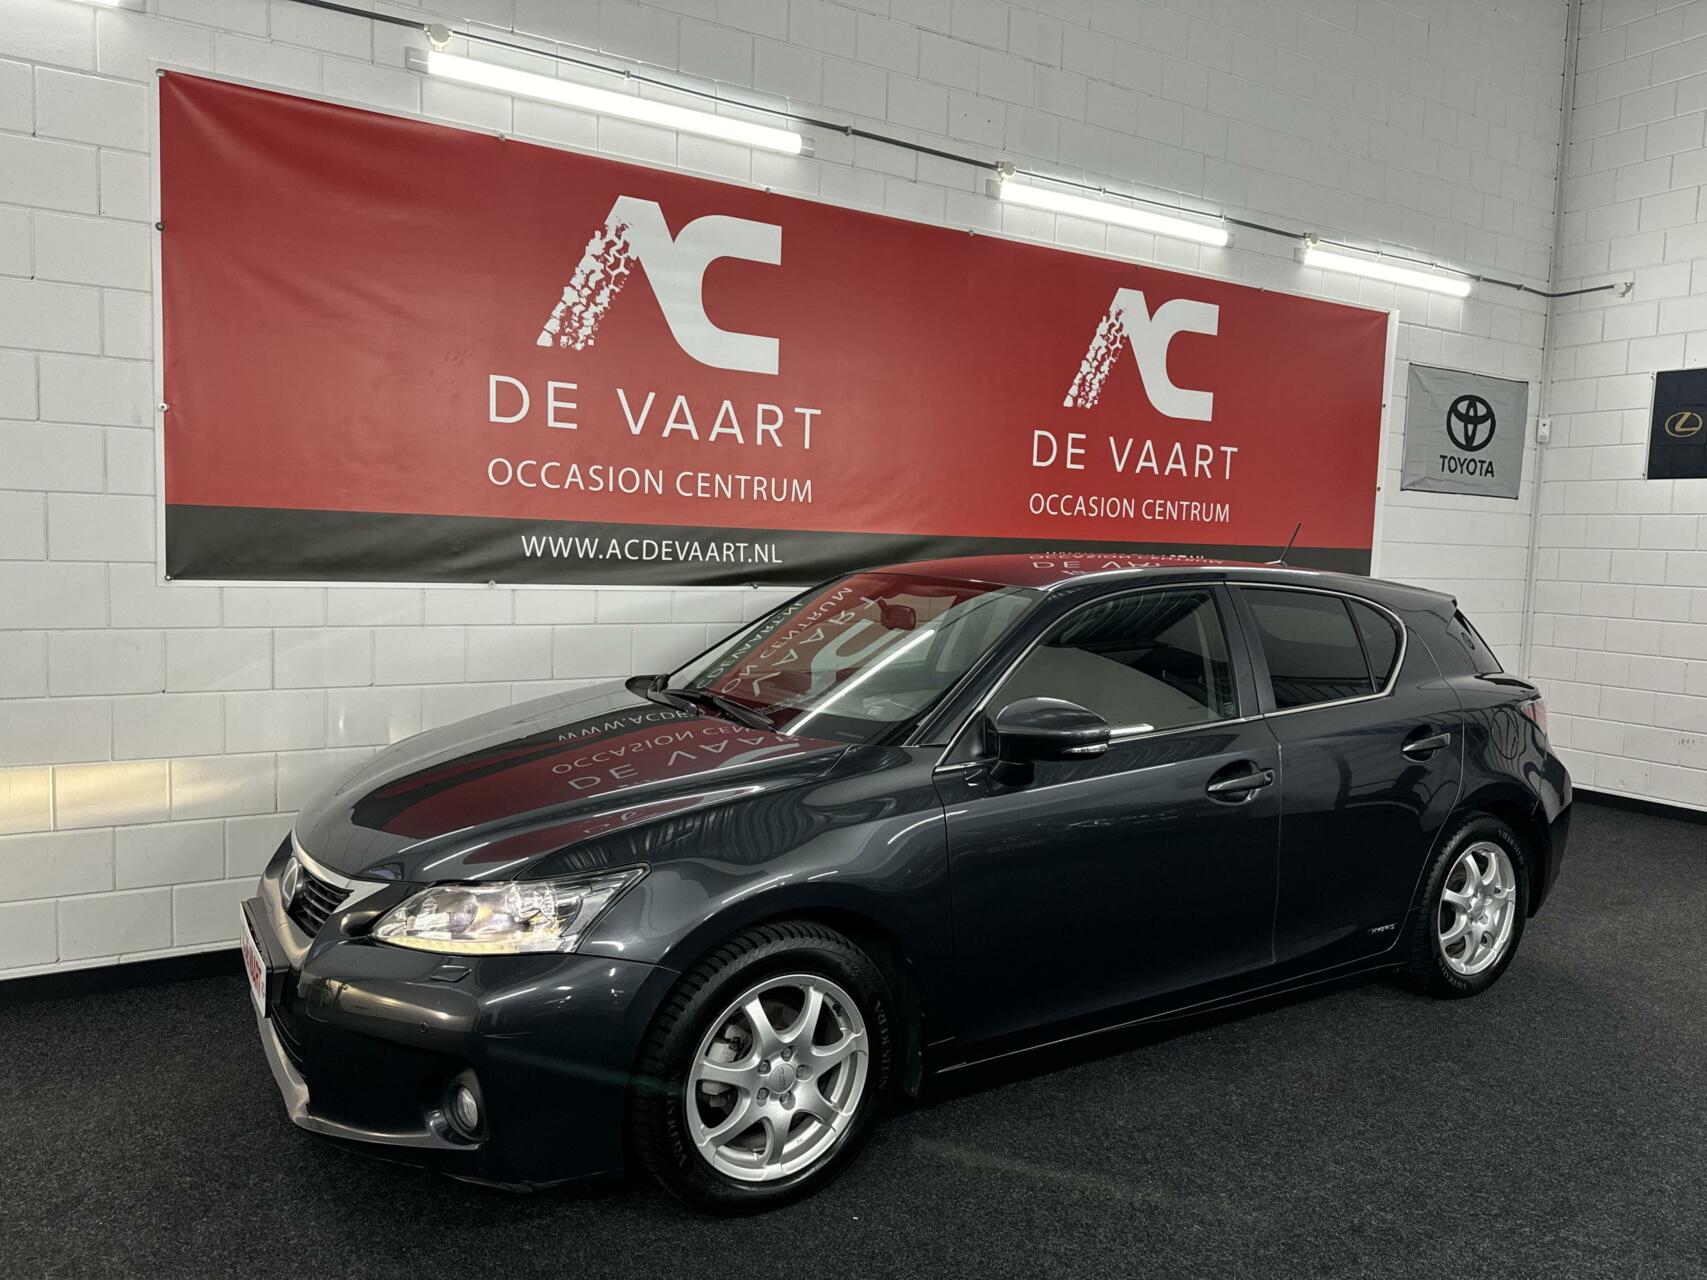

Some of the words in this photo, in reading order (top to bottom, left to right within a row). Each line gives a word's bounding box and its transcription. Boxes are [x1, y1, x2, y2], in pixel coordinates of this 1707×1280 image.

[536, 195, 782, 375] AC
[1063, 287, 1220, 422] AC
[488, 374, 578, 430] DE
[616, 388, 822, 450] VAART
[1032, 429, 1087, 470] DE
[1109, 436, 1239, 480] VAART
[1439, 454, 1495, 478] TOYOTA
[487, 457, 664, 496] OCCASION
[675, 471, 813, 503] CENTRUM
[1029, 492, 1135, 518] OCCASION
[1142, 499, 1230, 523] CENTRUM
[521, 535, 783, 564] WWW.ACDEVAART.NL
